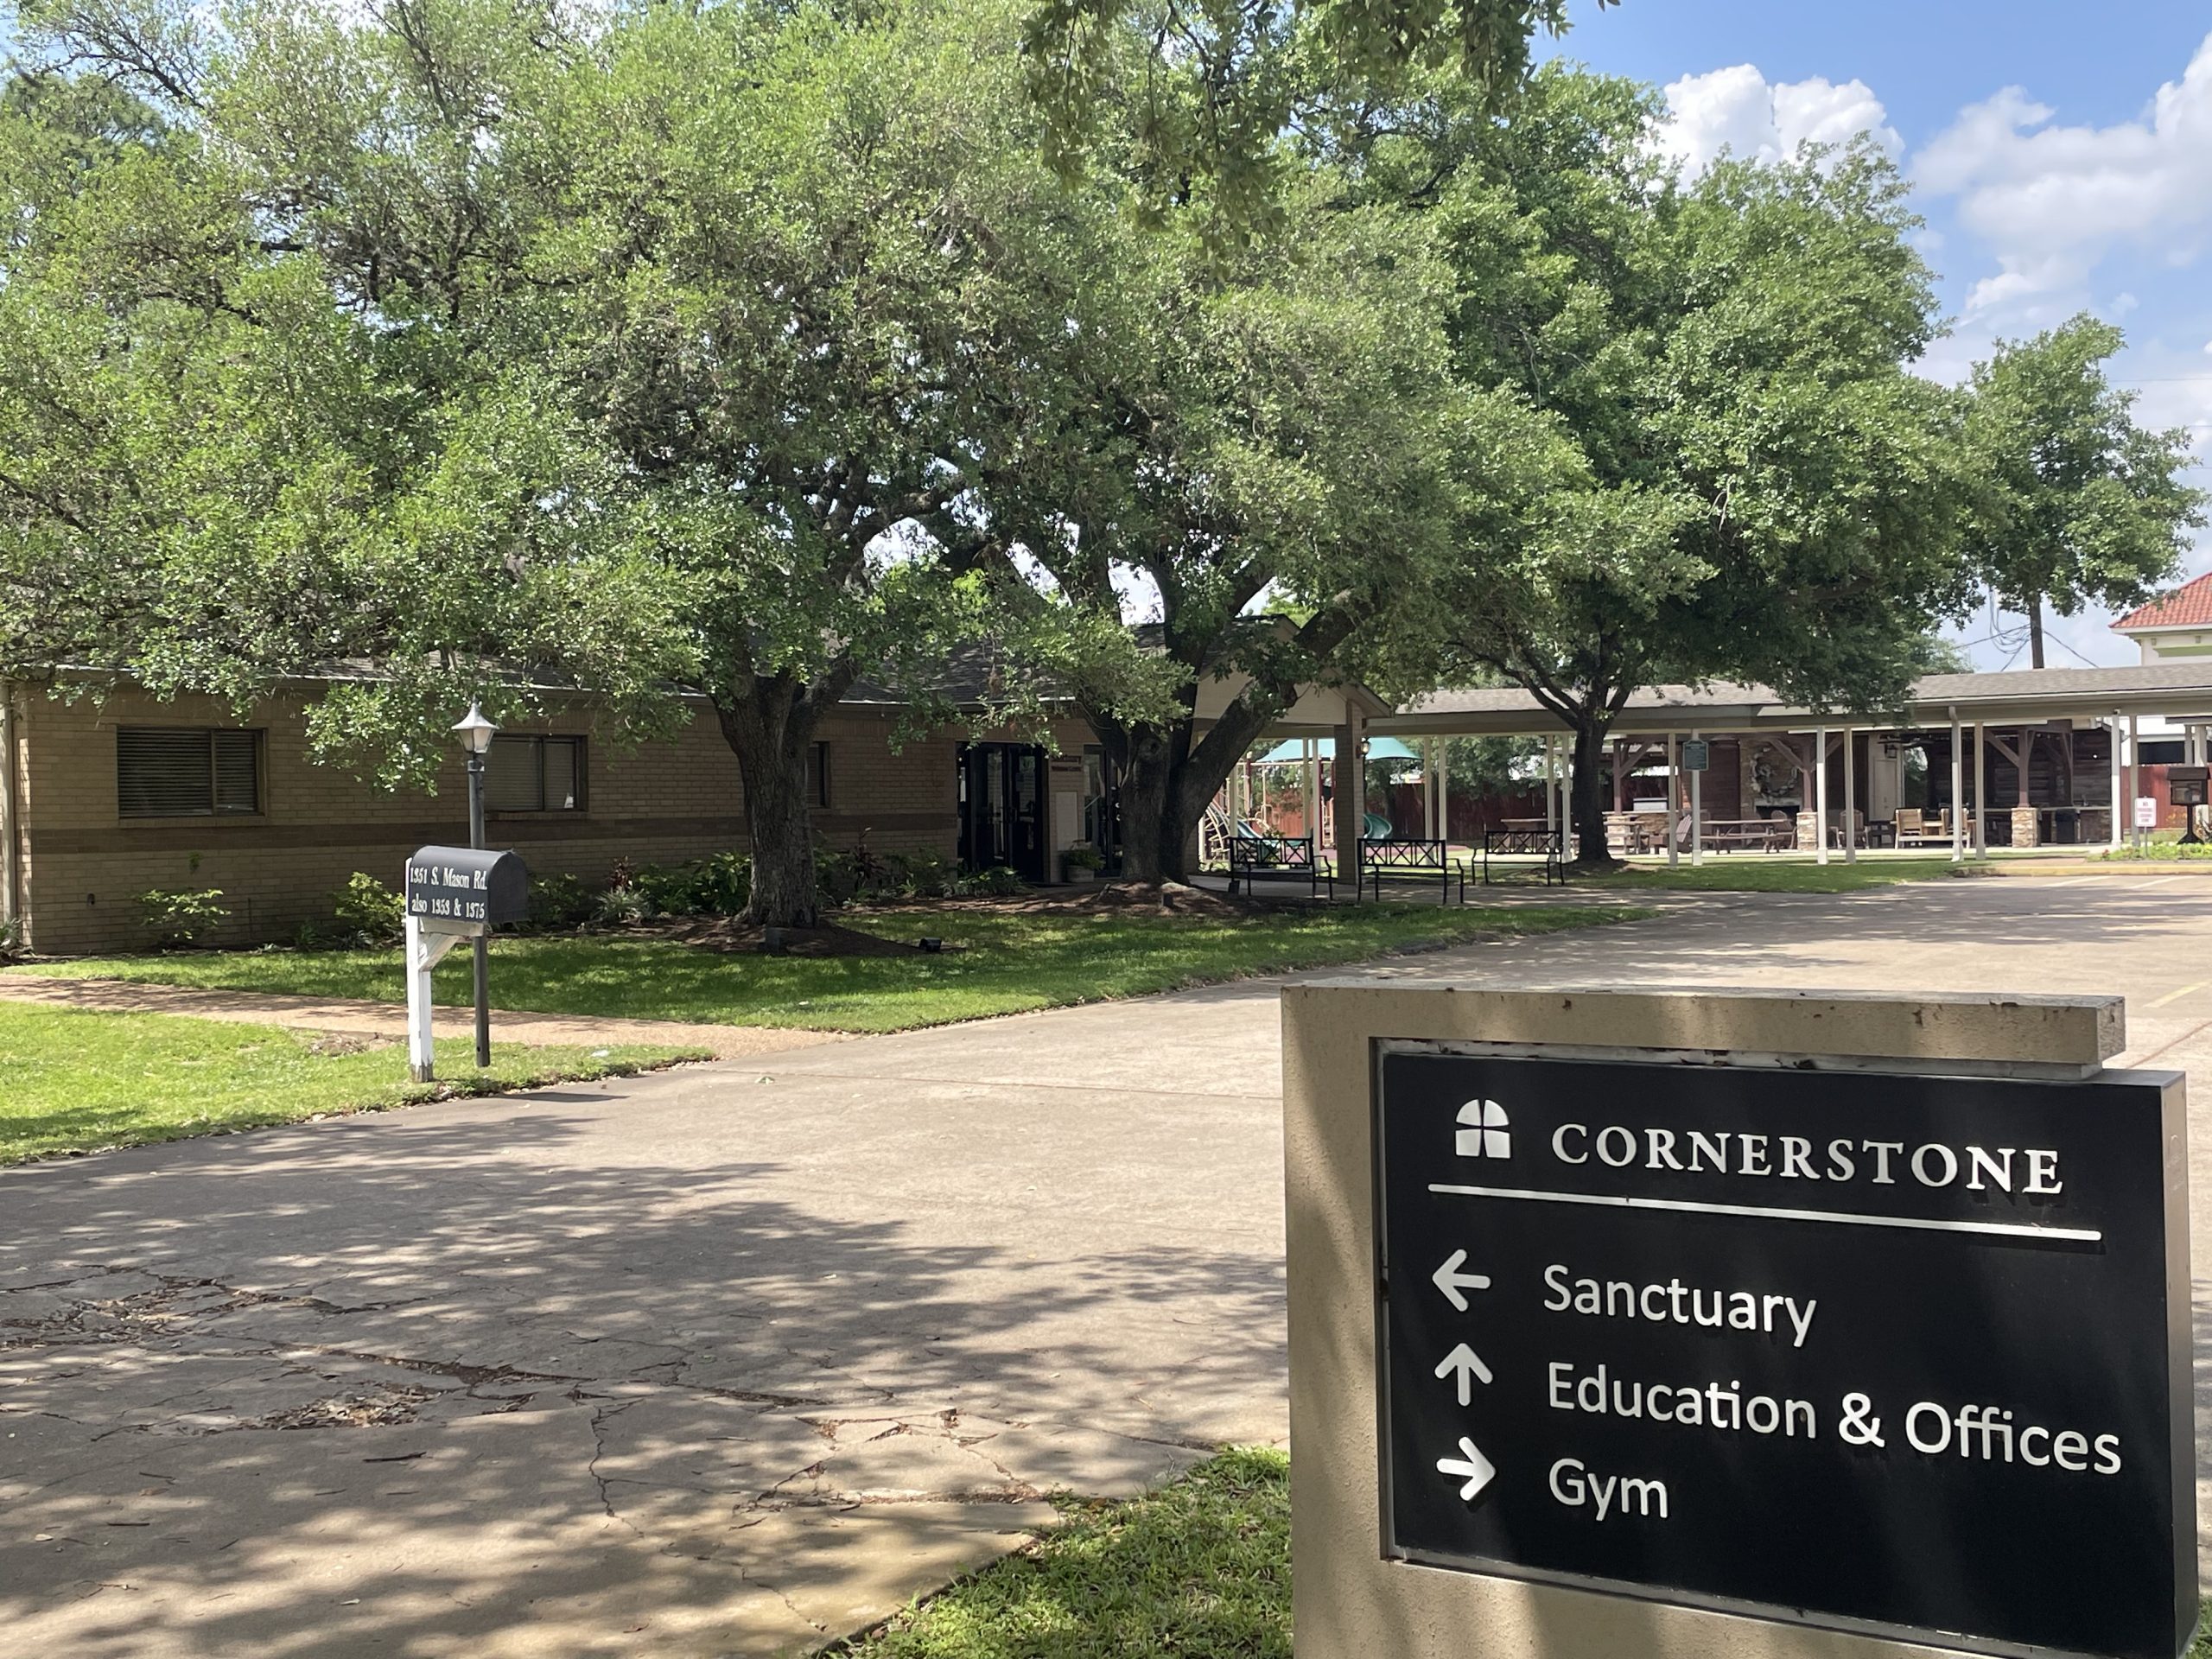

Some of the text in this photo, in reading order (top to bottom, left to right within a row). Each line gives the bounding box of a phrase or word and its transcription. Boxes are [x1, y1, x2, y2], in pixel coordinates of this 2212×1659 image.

[410, 867, 487, 890] 1351 S. Mason Rd.
[411, 893, 428, 912] also
[454, 898, 461, 916] &
[466, 902, 485, 918] 1375
[1552, 1123, 2063, 1195] CORNERSTONE
[1543, 1264, 1817, 1348] Sanctuary
[1548, 1362, 2122, 1476] Education & Offices
[1548, 1458, 1669, 1522] Gym
